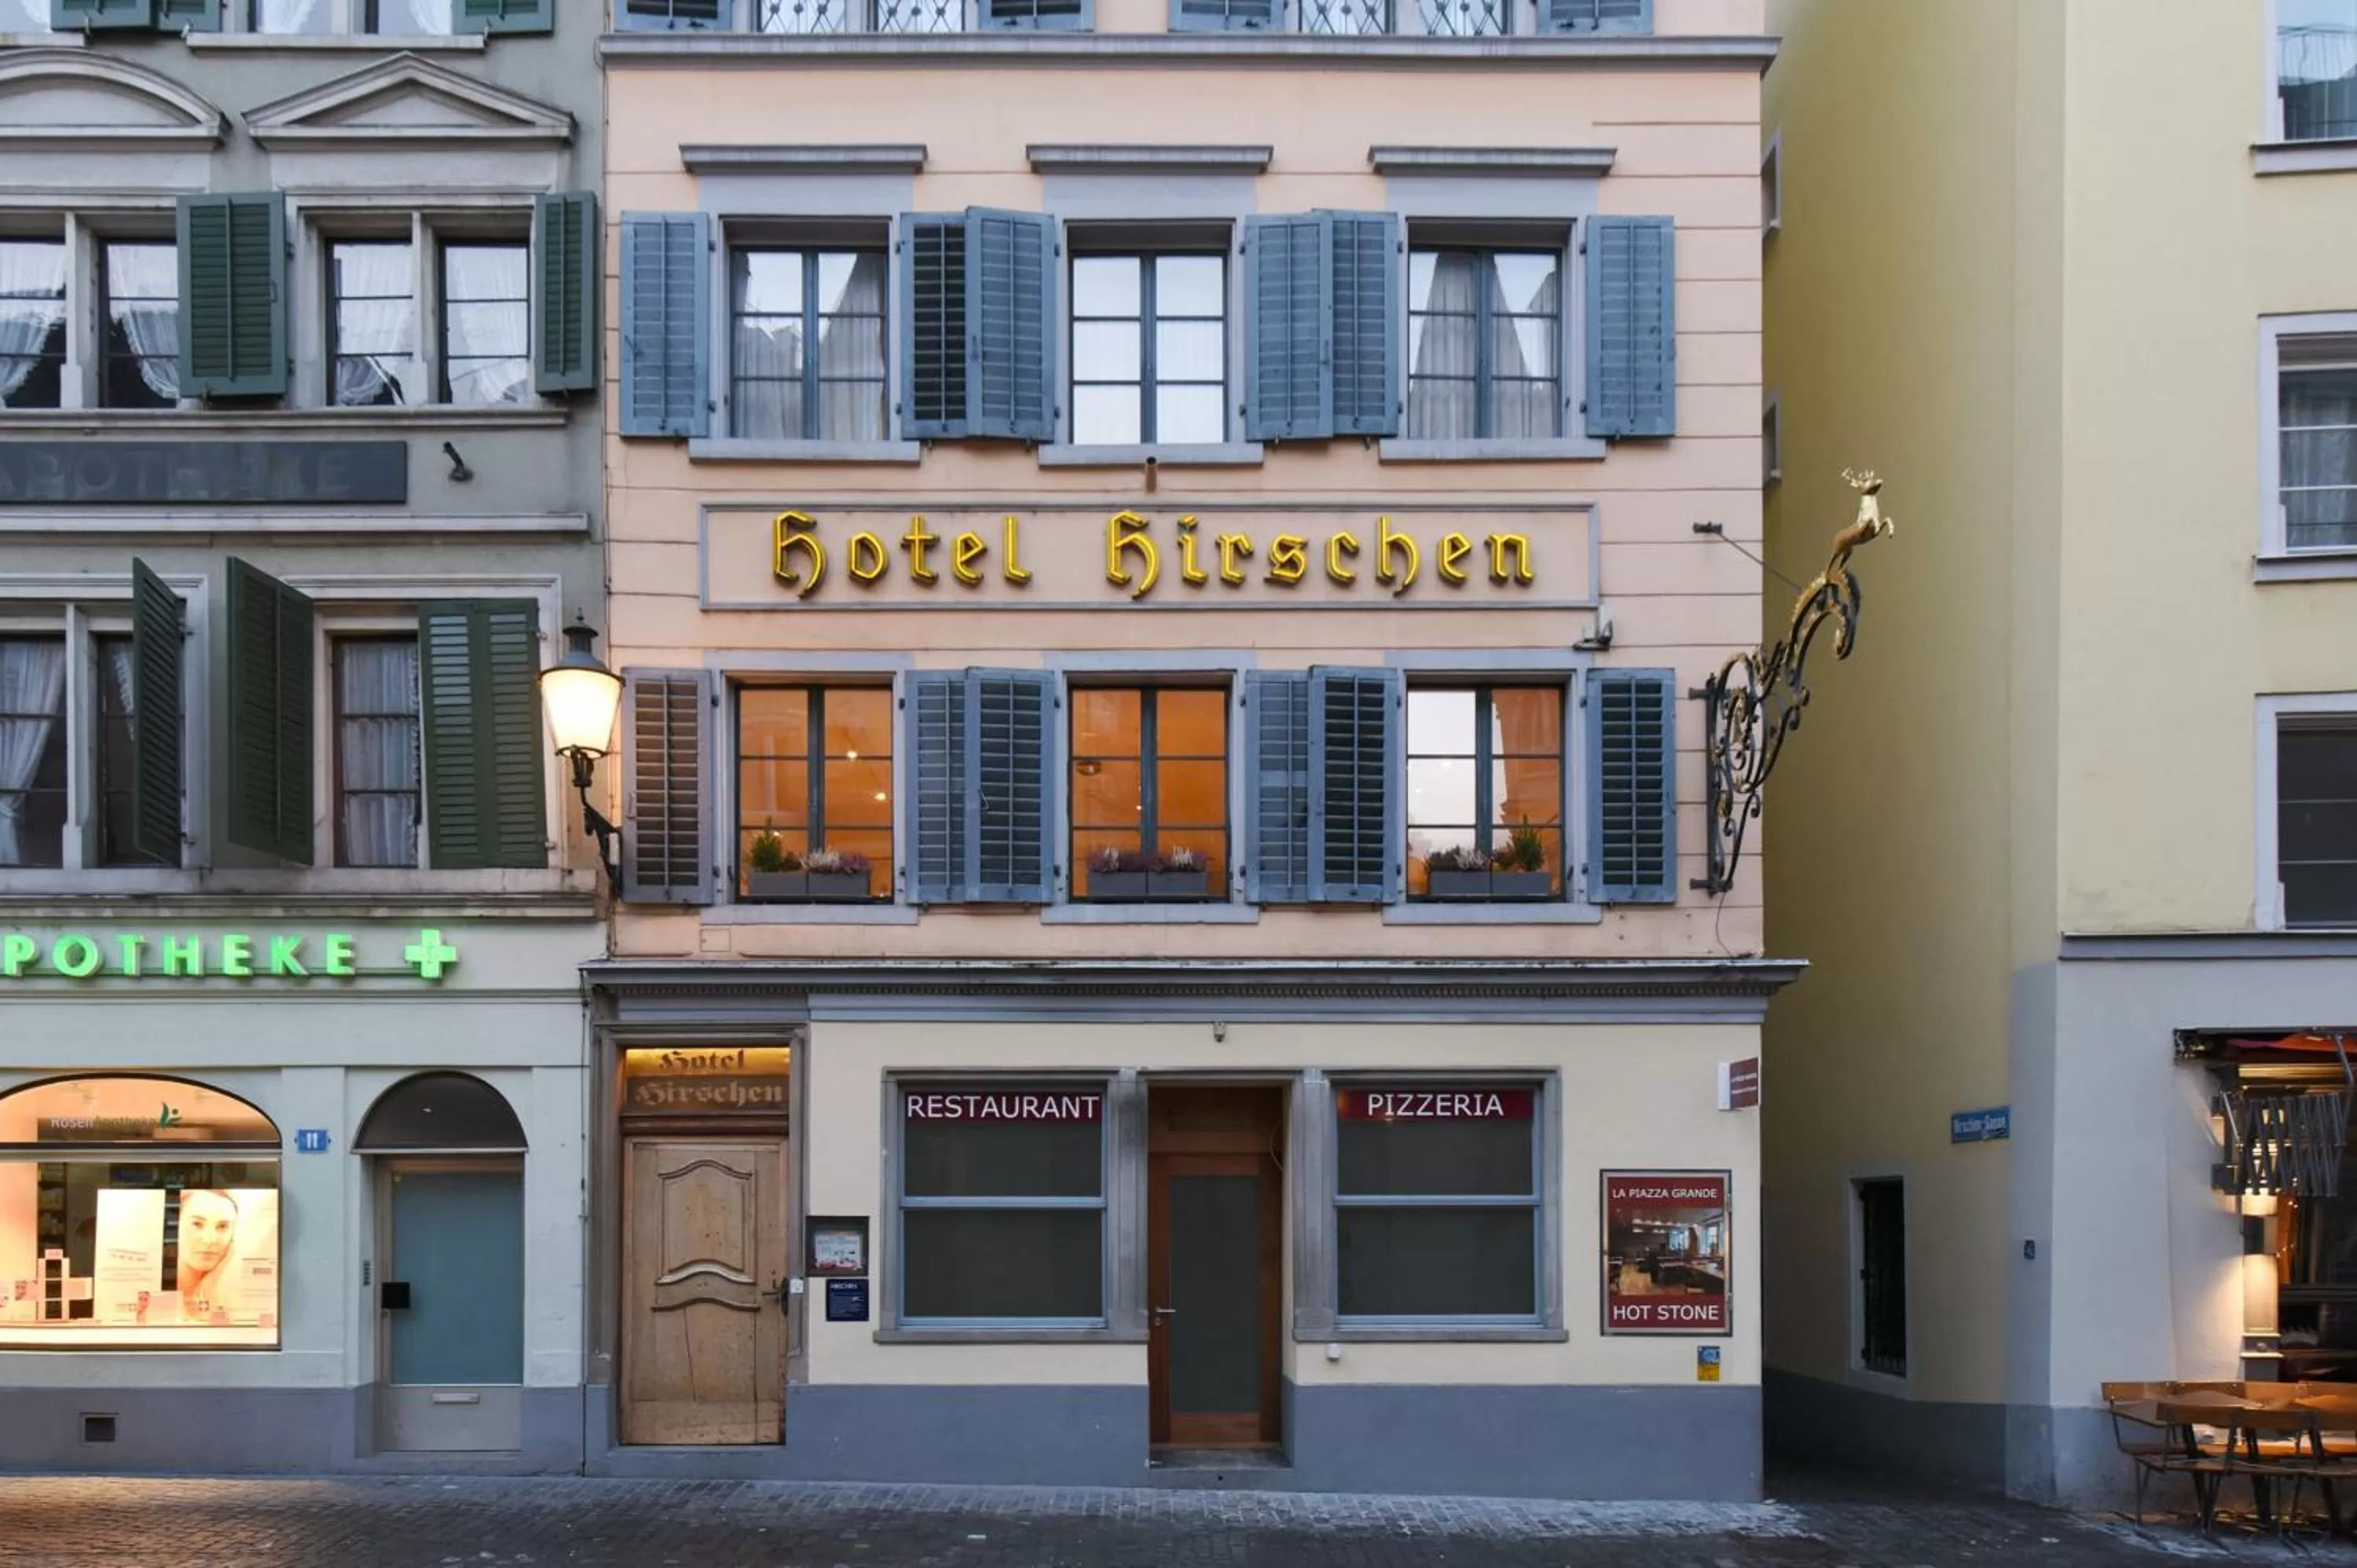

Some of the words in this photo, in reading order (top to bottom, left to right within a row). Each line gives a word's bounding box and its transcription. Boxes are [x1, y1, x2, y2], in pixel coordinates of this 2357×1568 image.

[772, 510, 1031, 599] Hotel
[1106, 510, 1535, 600] Hirschen
[4, 934, 356, 977] POTHEKE
[658, 1049, 745, 1069] Hotel
[635, 1081, 785, 1107] Hirschen
[1368, 1094, 1504, 1116] PIZZERIA
[907, 1095, 1099, 1119] RESTAURANT
[306, 1132, 318, 1149] 11
[1613, 1189, 1626, 1198] LA
[1629, 1189, 1668, 1198] PIAZZA
[1671, 1189, 1717, 1198] GRANDE
[1614, 1305, 1652, 1321] HOT
[1657, 1305, 1719, 1321] STONE
